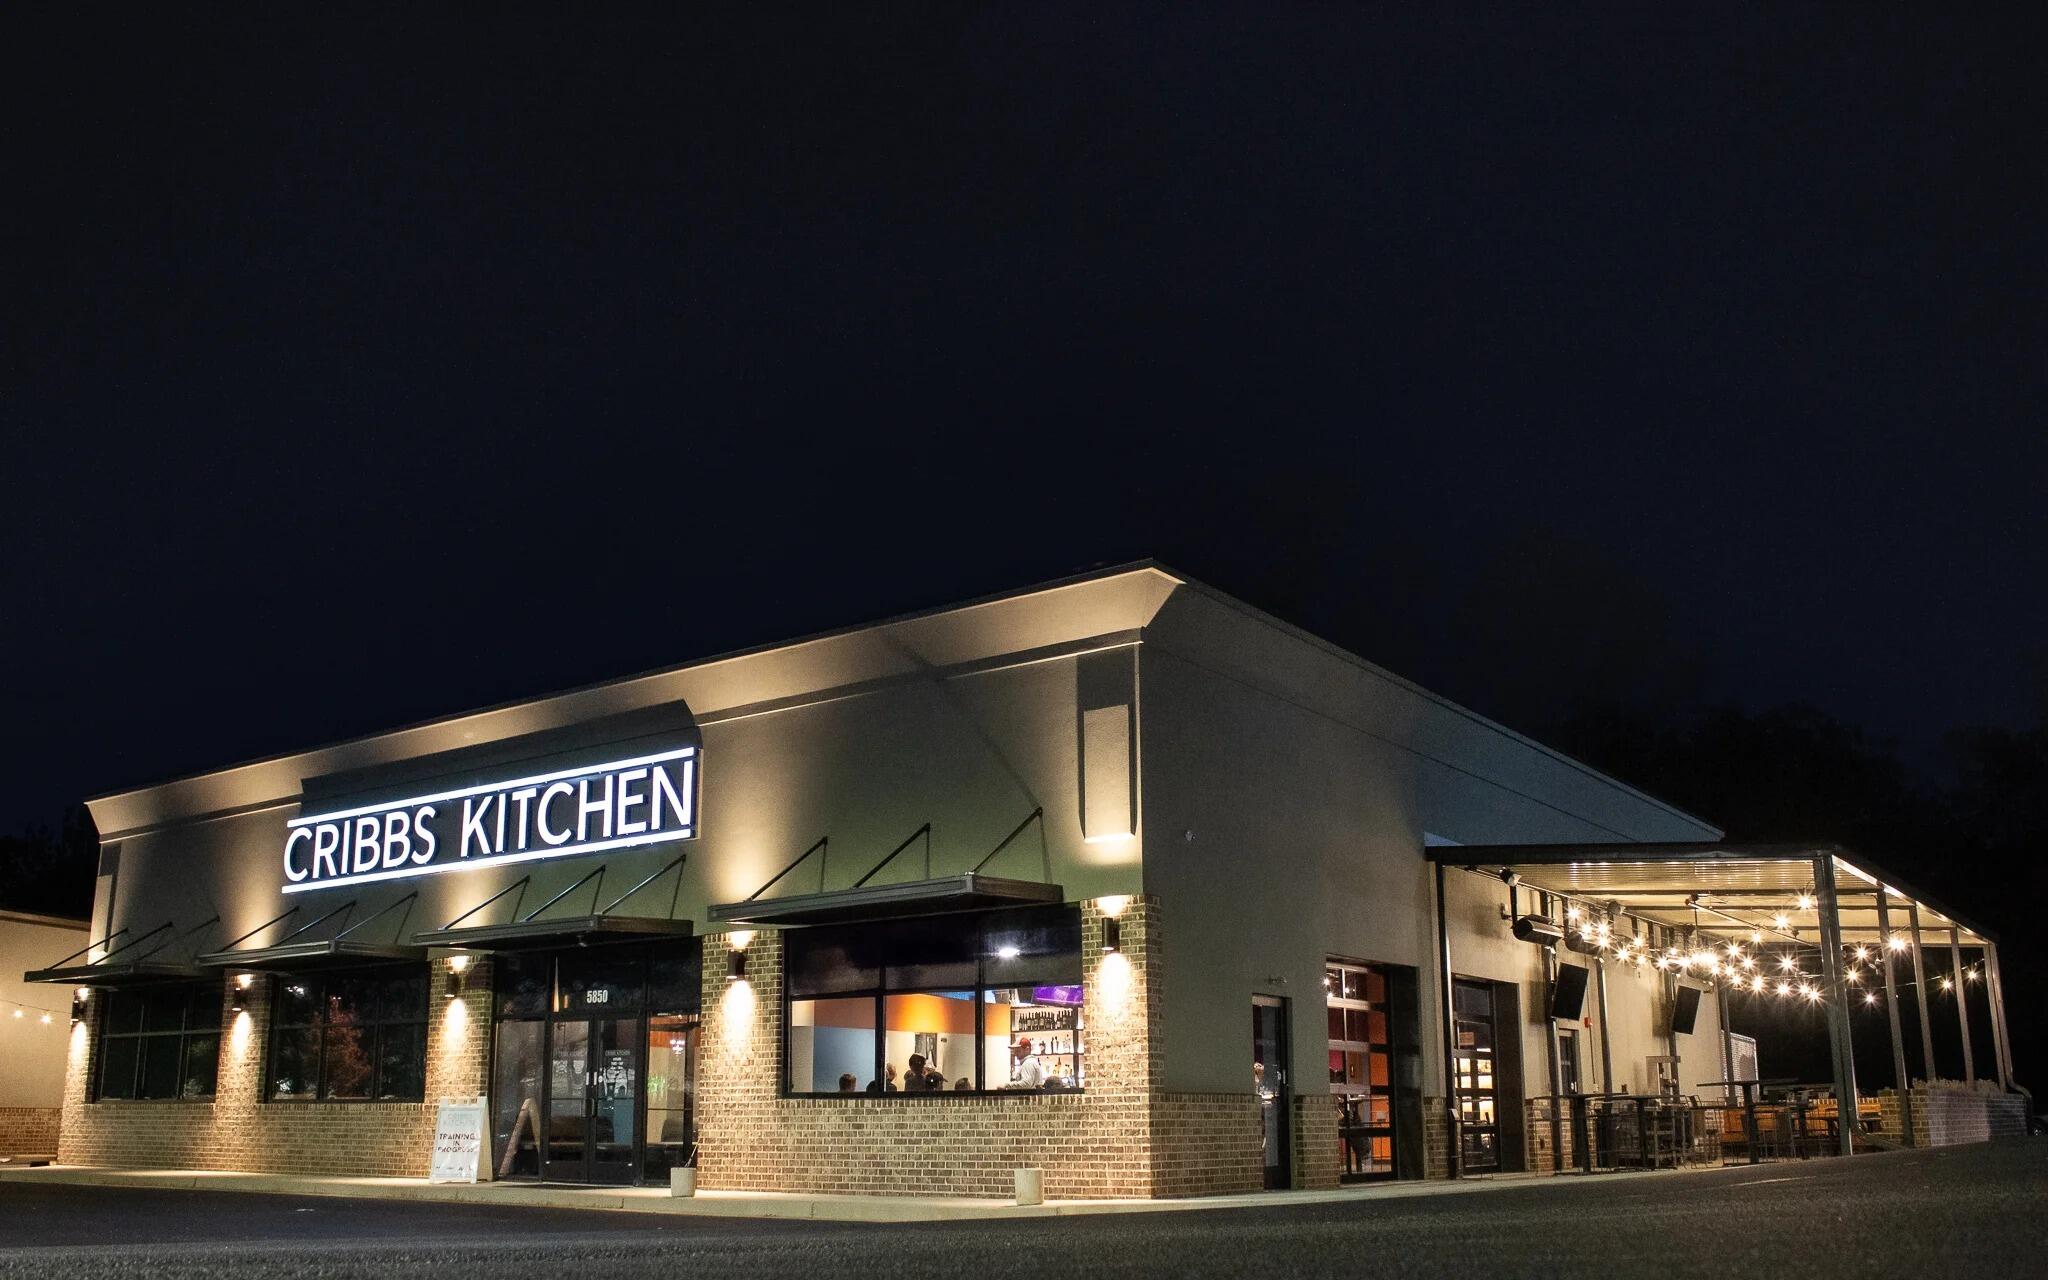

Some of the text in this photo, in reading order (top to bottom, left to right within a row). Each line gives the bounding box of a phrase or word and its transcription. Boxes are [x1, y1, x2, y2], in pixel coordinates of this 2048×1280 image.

[284, 760, 693, 881] CRIBBS KITCHEN
[587, 989, 608, 1004] 5850
